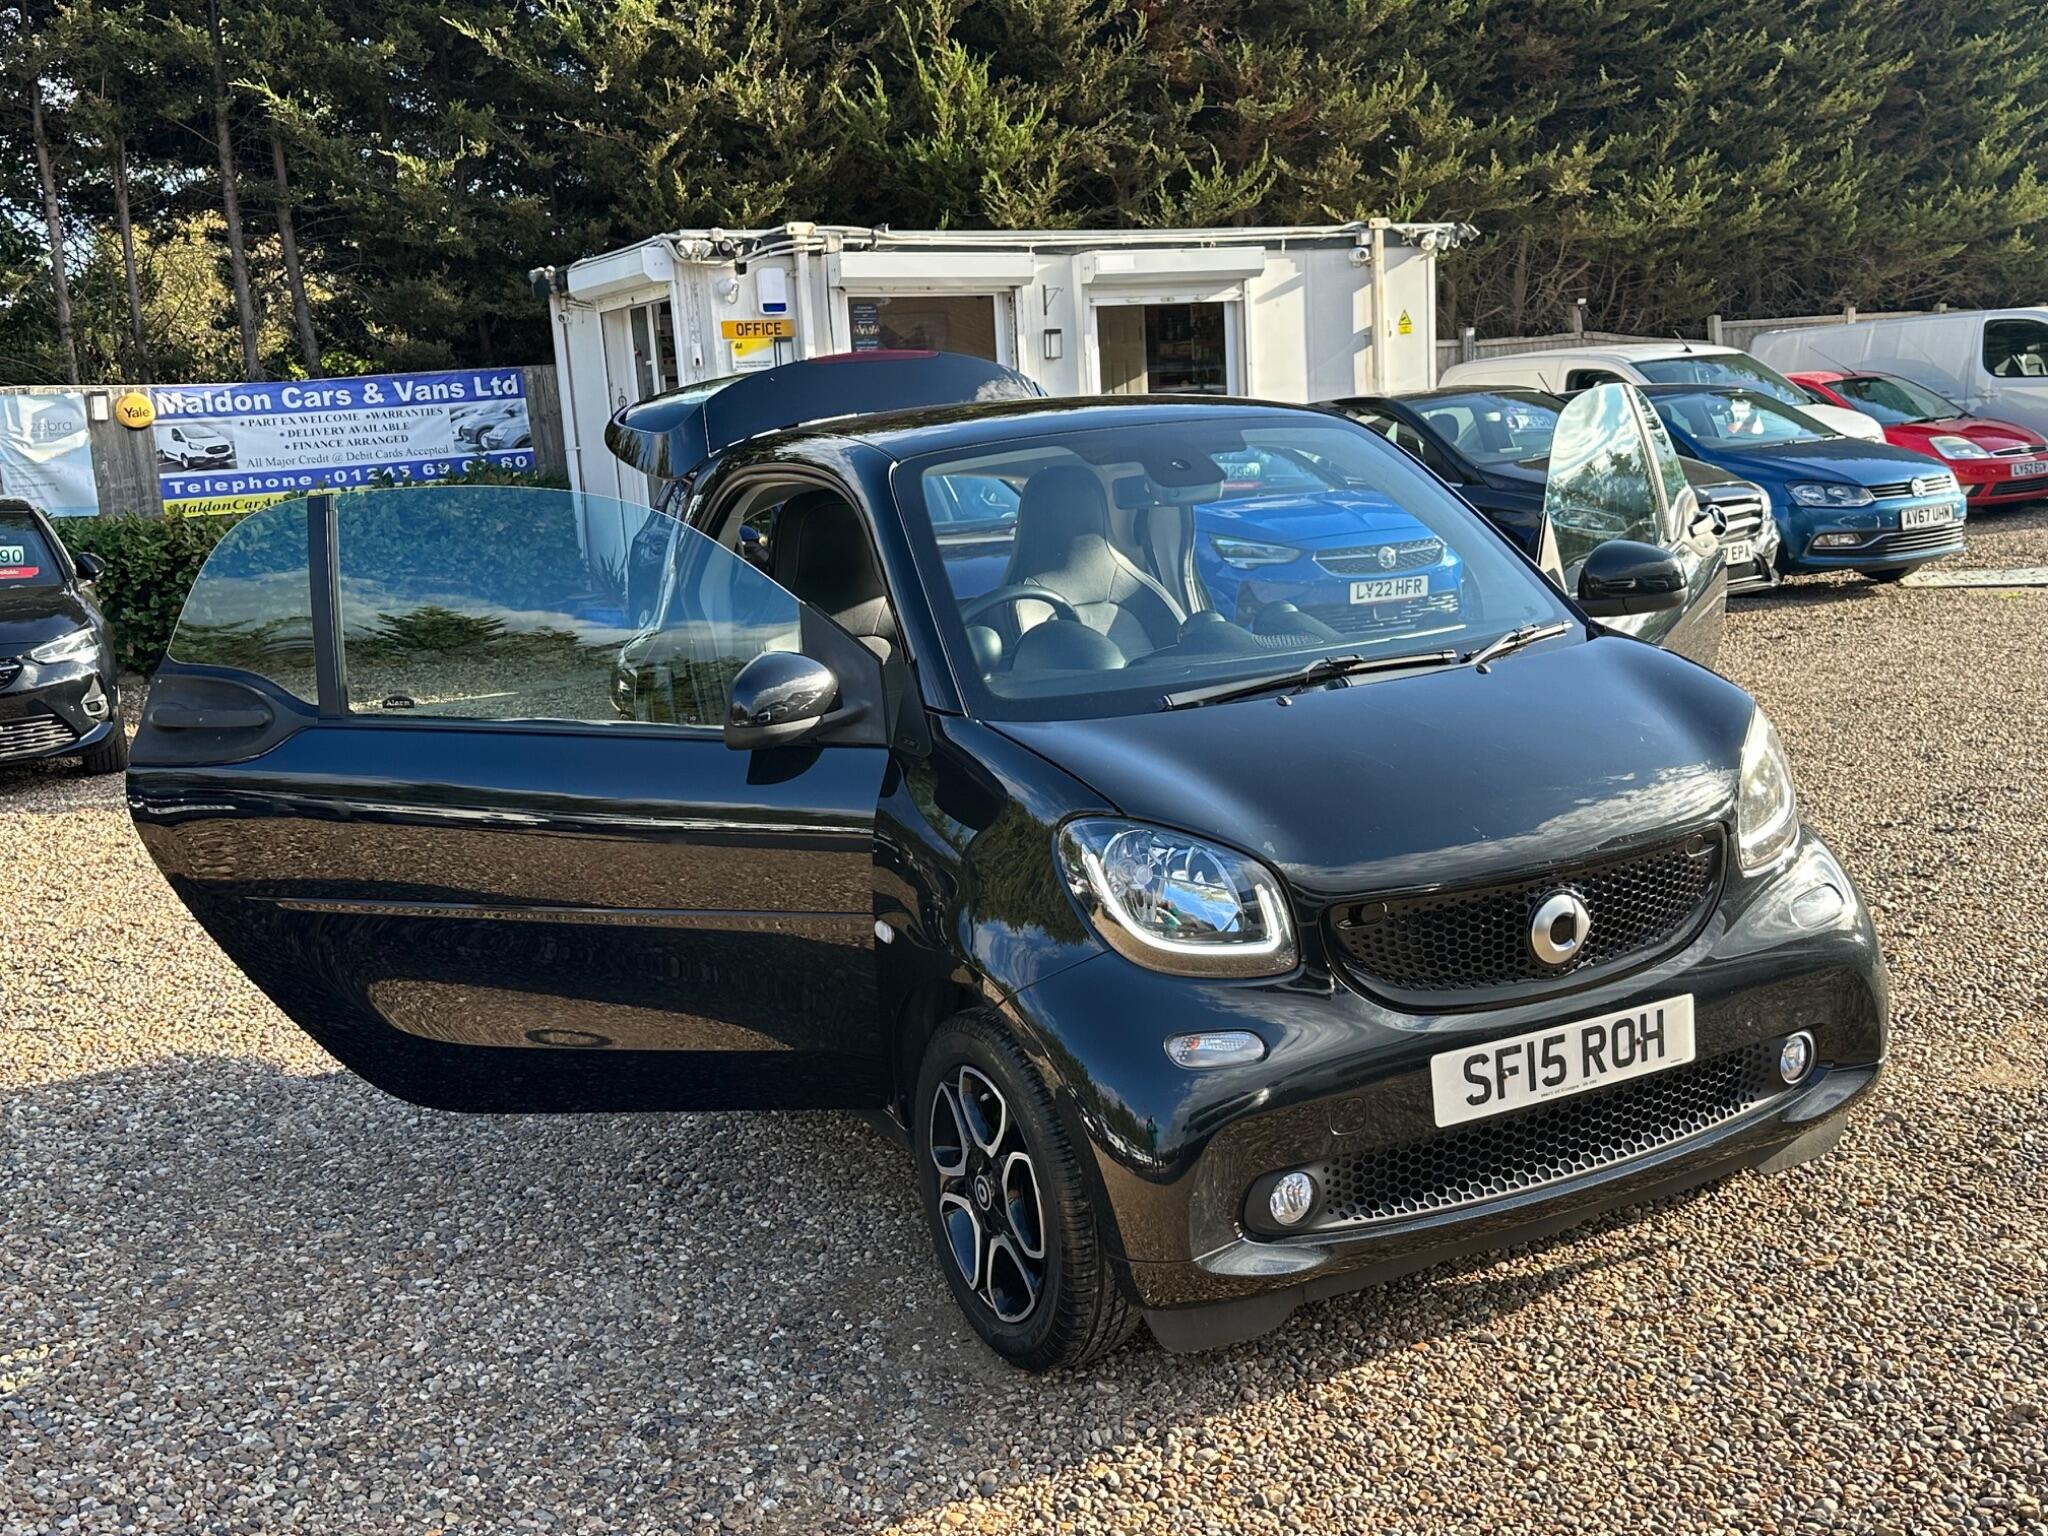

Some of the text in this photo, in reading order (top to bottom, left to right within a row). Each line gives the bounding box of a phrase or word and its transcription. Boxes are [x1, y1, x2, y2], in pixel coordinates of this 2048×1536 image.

[736, 322, 782, 336] OFFICE
[156, 374, 519, 416] Maldon Cars & Vans Ltd
[124, 407, 150, 418] Yale
[249, 418, 277, 427] PART
[281, 416, 296, 426] EX
[300, 413, 360, 424] WELCOME
[31, 420, 73, 431] zebra
[288, 422, 409, 438] DELIVERY AVAILABLE
[293, 435, 408, 450] FINANCE ARRANGED
[247, 459, 262, 468] All
[265, 456, 295, 468] Major
[299, 453, 329, 464] Credit
[346, 450, 373, 462] Debit
[375, 448, 403, 460] Cards
[403, 445, 449, 458] Accepted
[169, 475, 312, 494] Telephone
[1731, 545, 1750, 560] EPA
[1356, 578, 1422, 600] LY22 HFR
[1463, 1009, 1665, 1106] SF15 ROH
